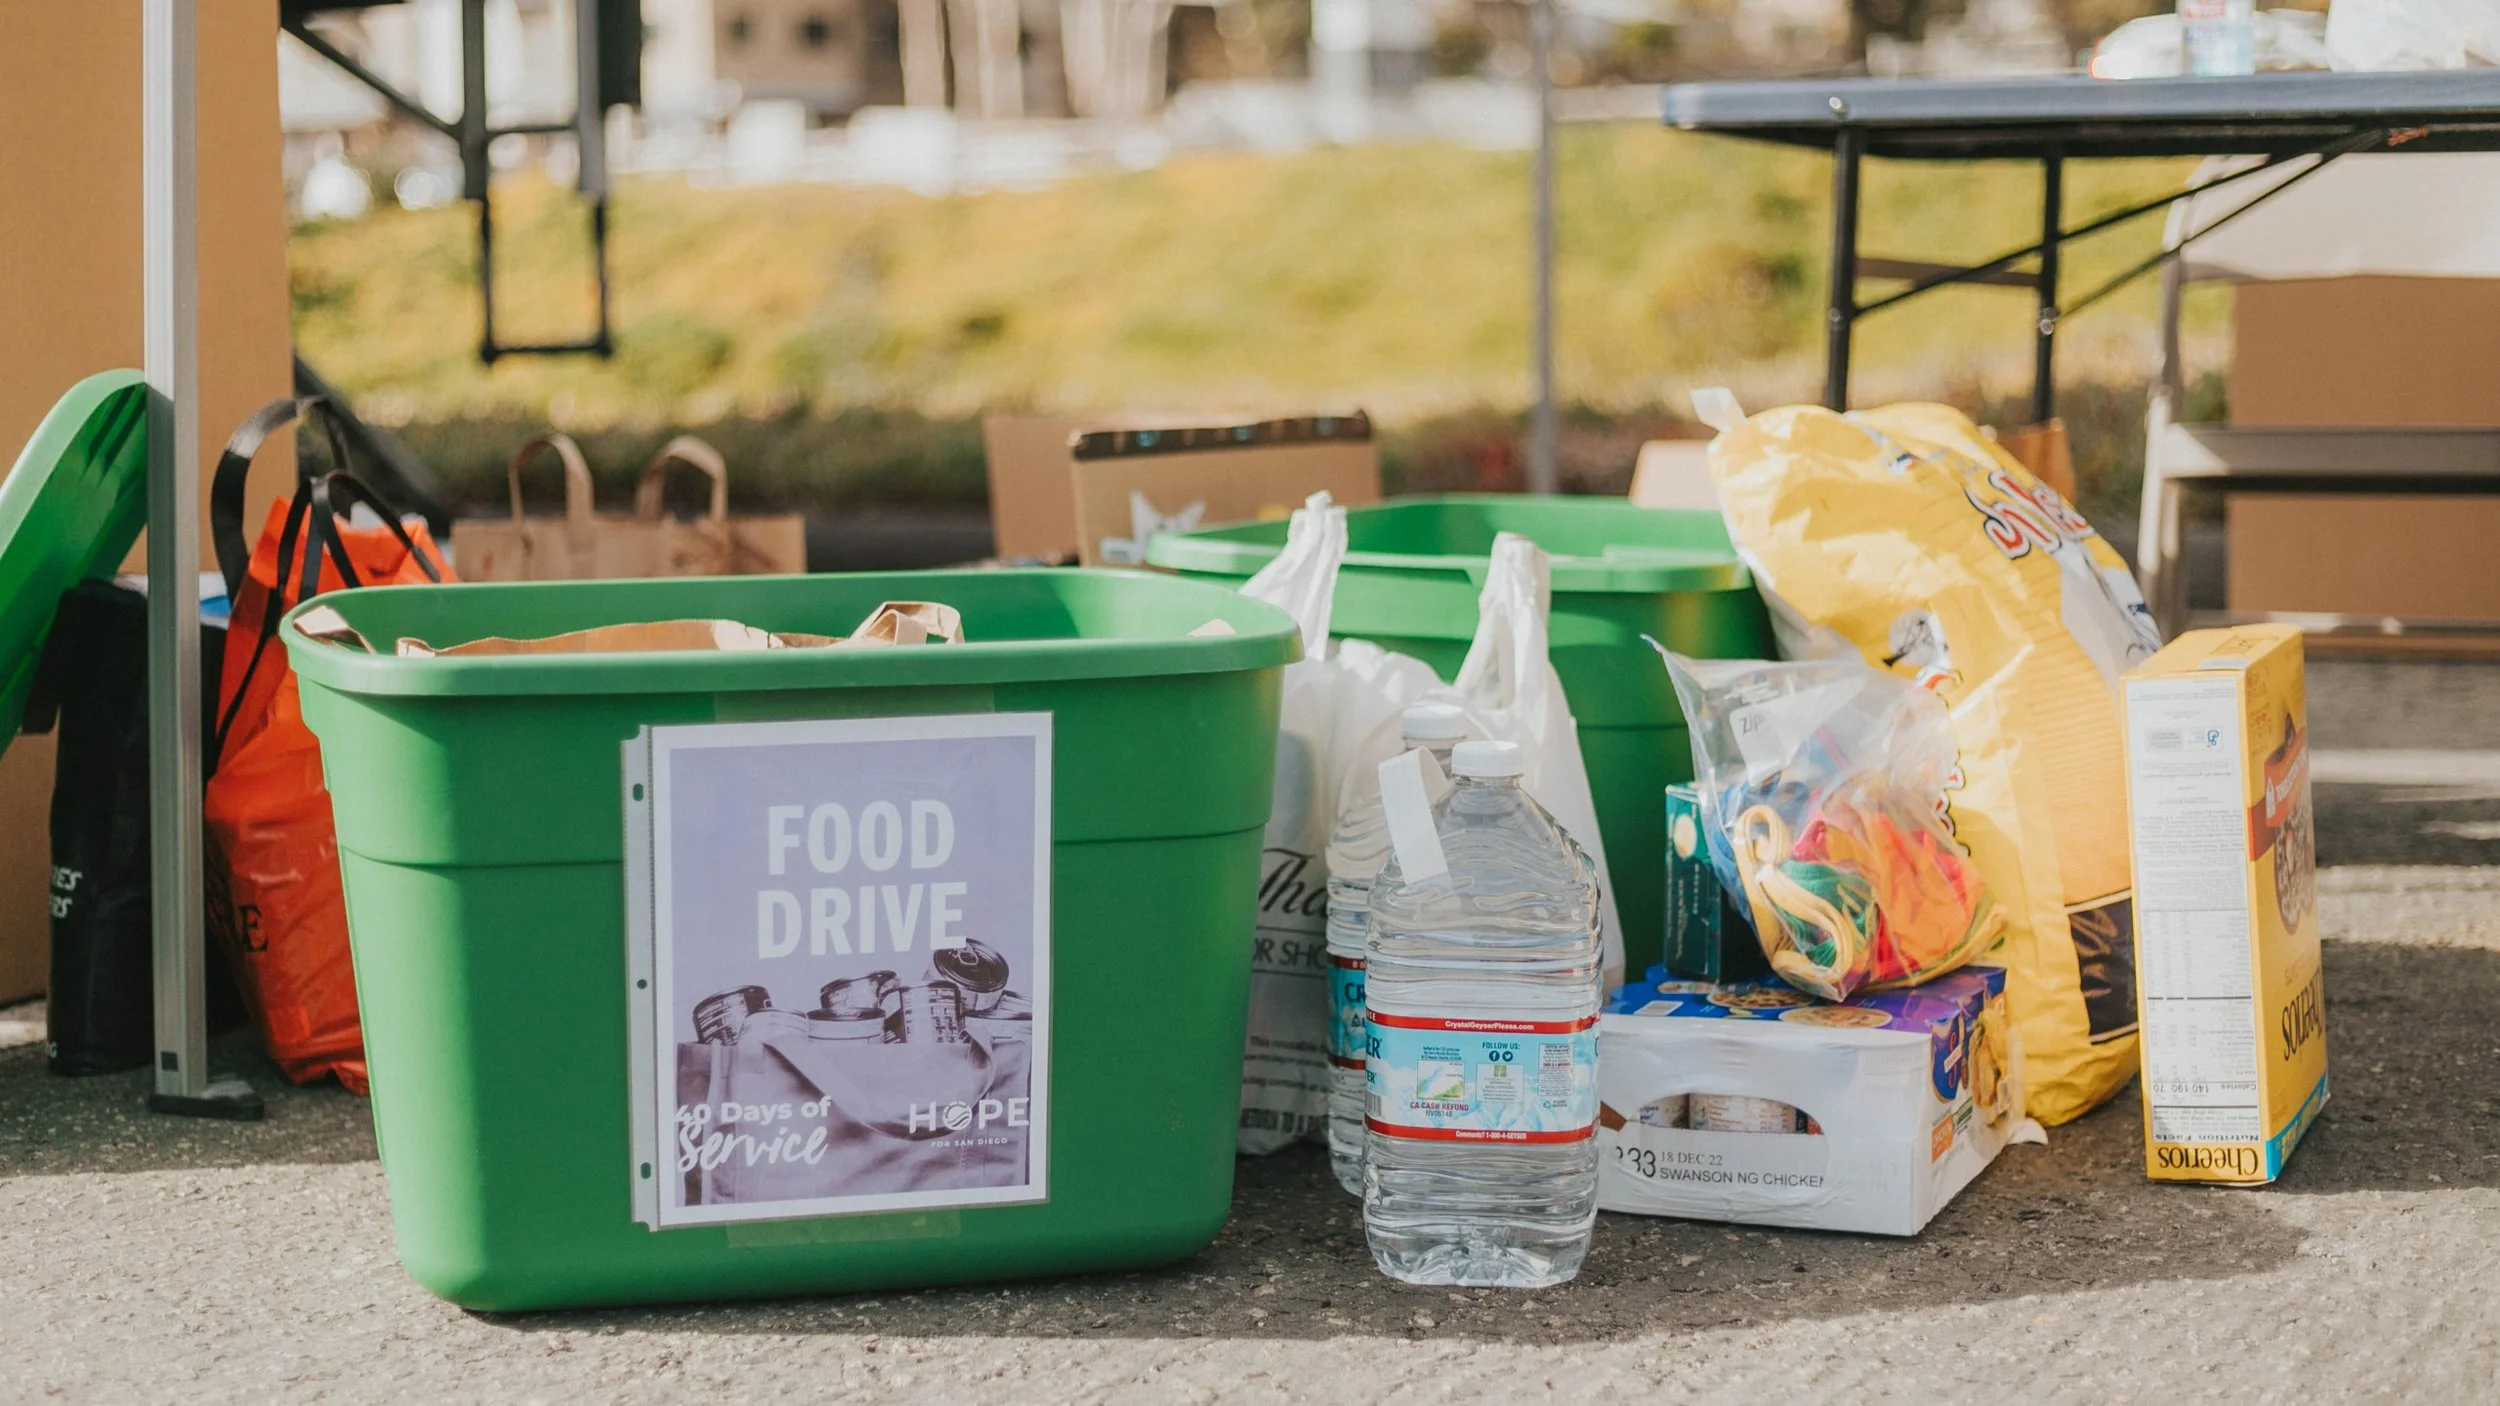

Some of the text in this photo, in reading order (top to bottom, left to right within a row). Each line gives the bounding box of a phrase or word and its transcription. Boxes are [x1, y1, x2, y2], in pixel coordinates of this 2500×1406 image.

[768, 799, 955, 875] FOOD
[1258, 848, 1328, 918] Tha
[758, 882, 967, 959] DRIVE
[1445, 1020, 1534, 1030] CrystalGeyserPlease.com
[1481, 1042, 1521, 1050] FOLLOW US:
[2192, 1083, 2209, 1093] 140
[2221, 1083, 2257, 1091] Calories
[674, 1096, 832, 1126] 40 Days of
[1410, 1101, 1470, 1111] CA CASH REFUND
[909, 1097, 1030, 1134] HOPE
[677, 1121, 829, 1173] Service
[978, 1137, 1008, 1145] DIEGO
[1661, 1151, 1723, 1166] 18 DEC 22
[2157, 1146, 2259, 1176] Cheerios
[1659, 1168, 1733, 1184] SWANSON
[1737, 1172, 1759, 1185] NG
